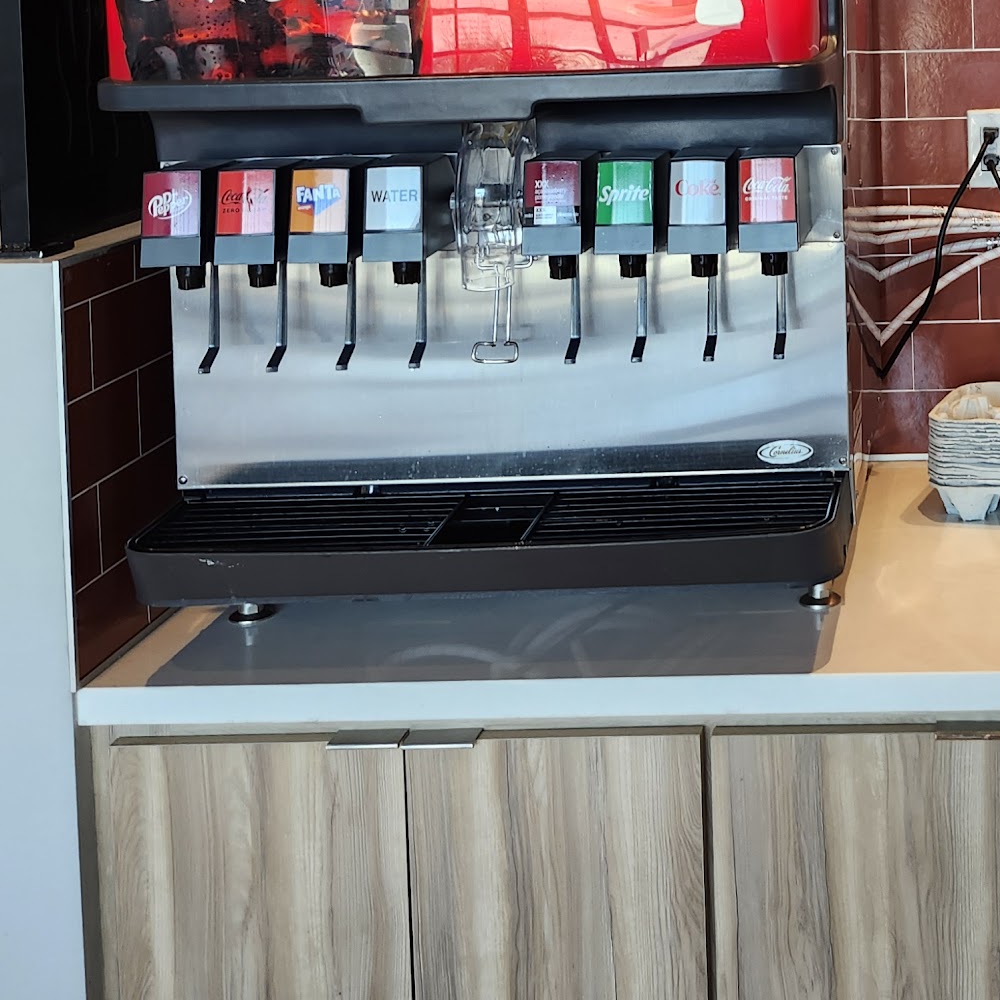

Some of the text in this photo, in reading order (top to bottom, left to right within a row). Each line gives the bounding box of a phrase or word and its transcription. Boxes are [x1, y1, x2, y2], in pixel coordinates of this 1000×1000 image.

[296, 184, 341, 203] FANTA
[598, 184, 650, 206] Sprite
[675, 179, 720, 197] Coke
[742, 176, 792, 195] Coca-Cola
[371, 189, 418, 202] WATER
